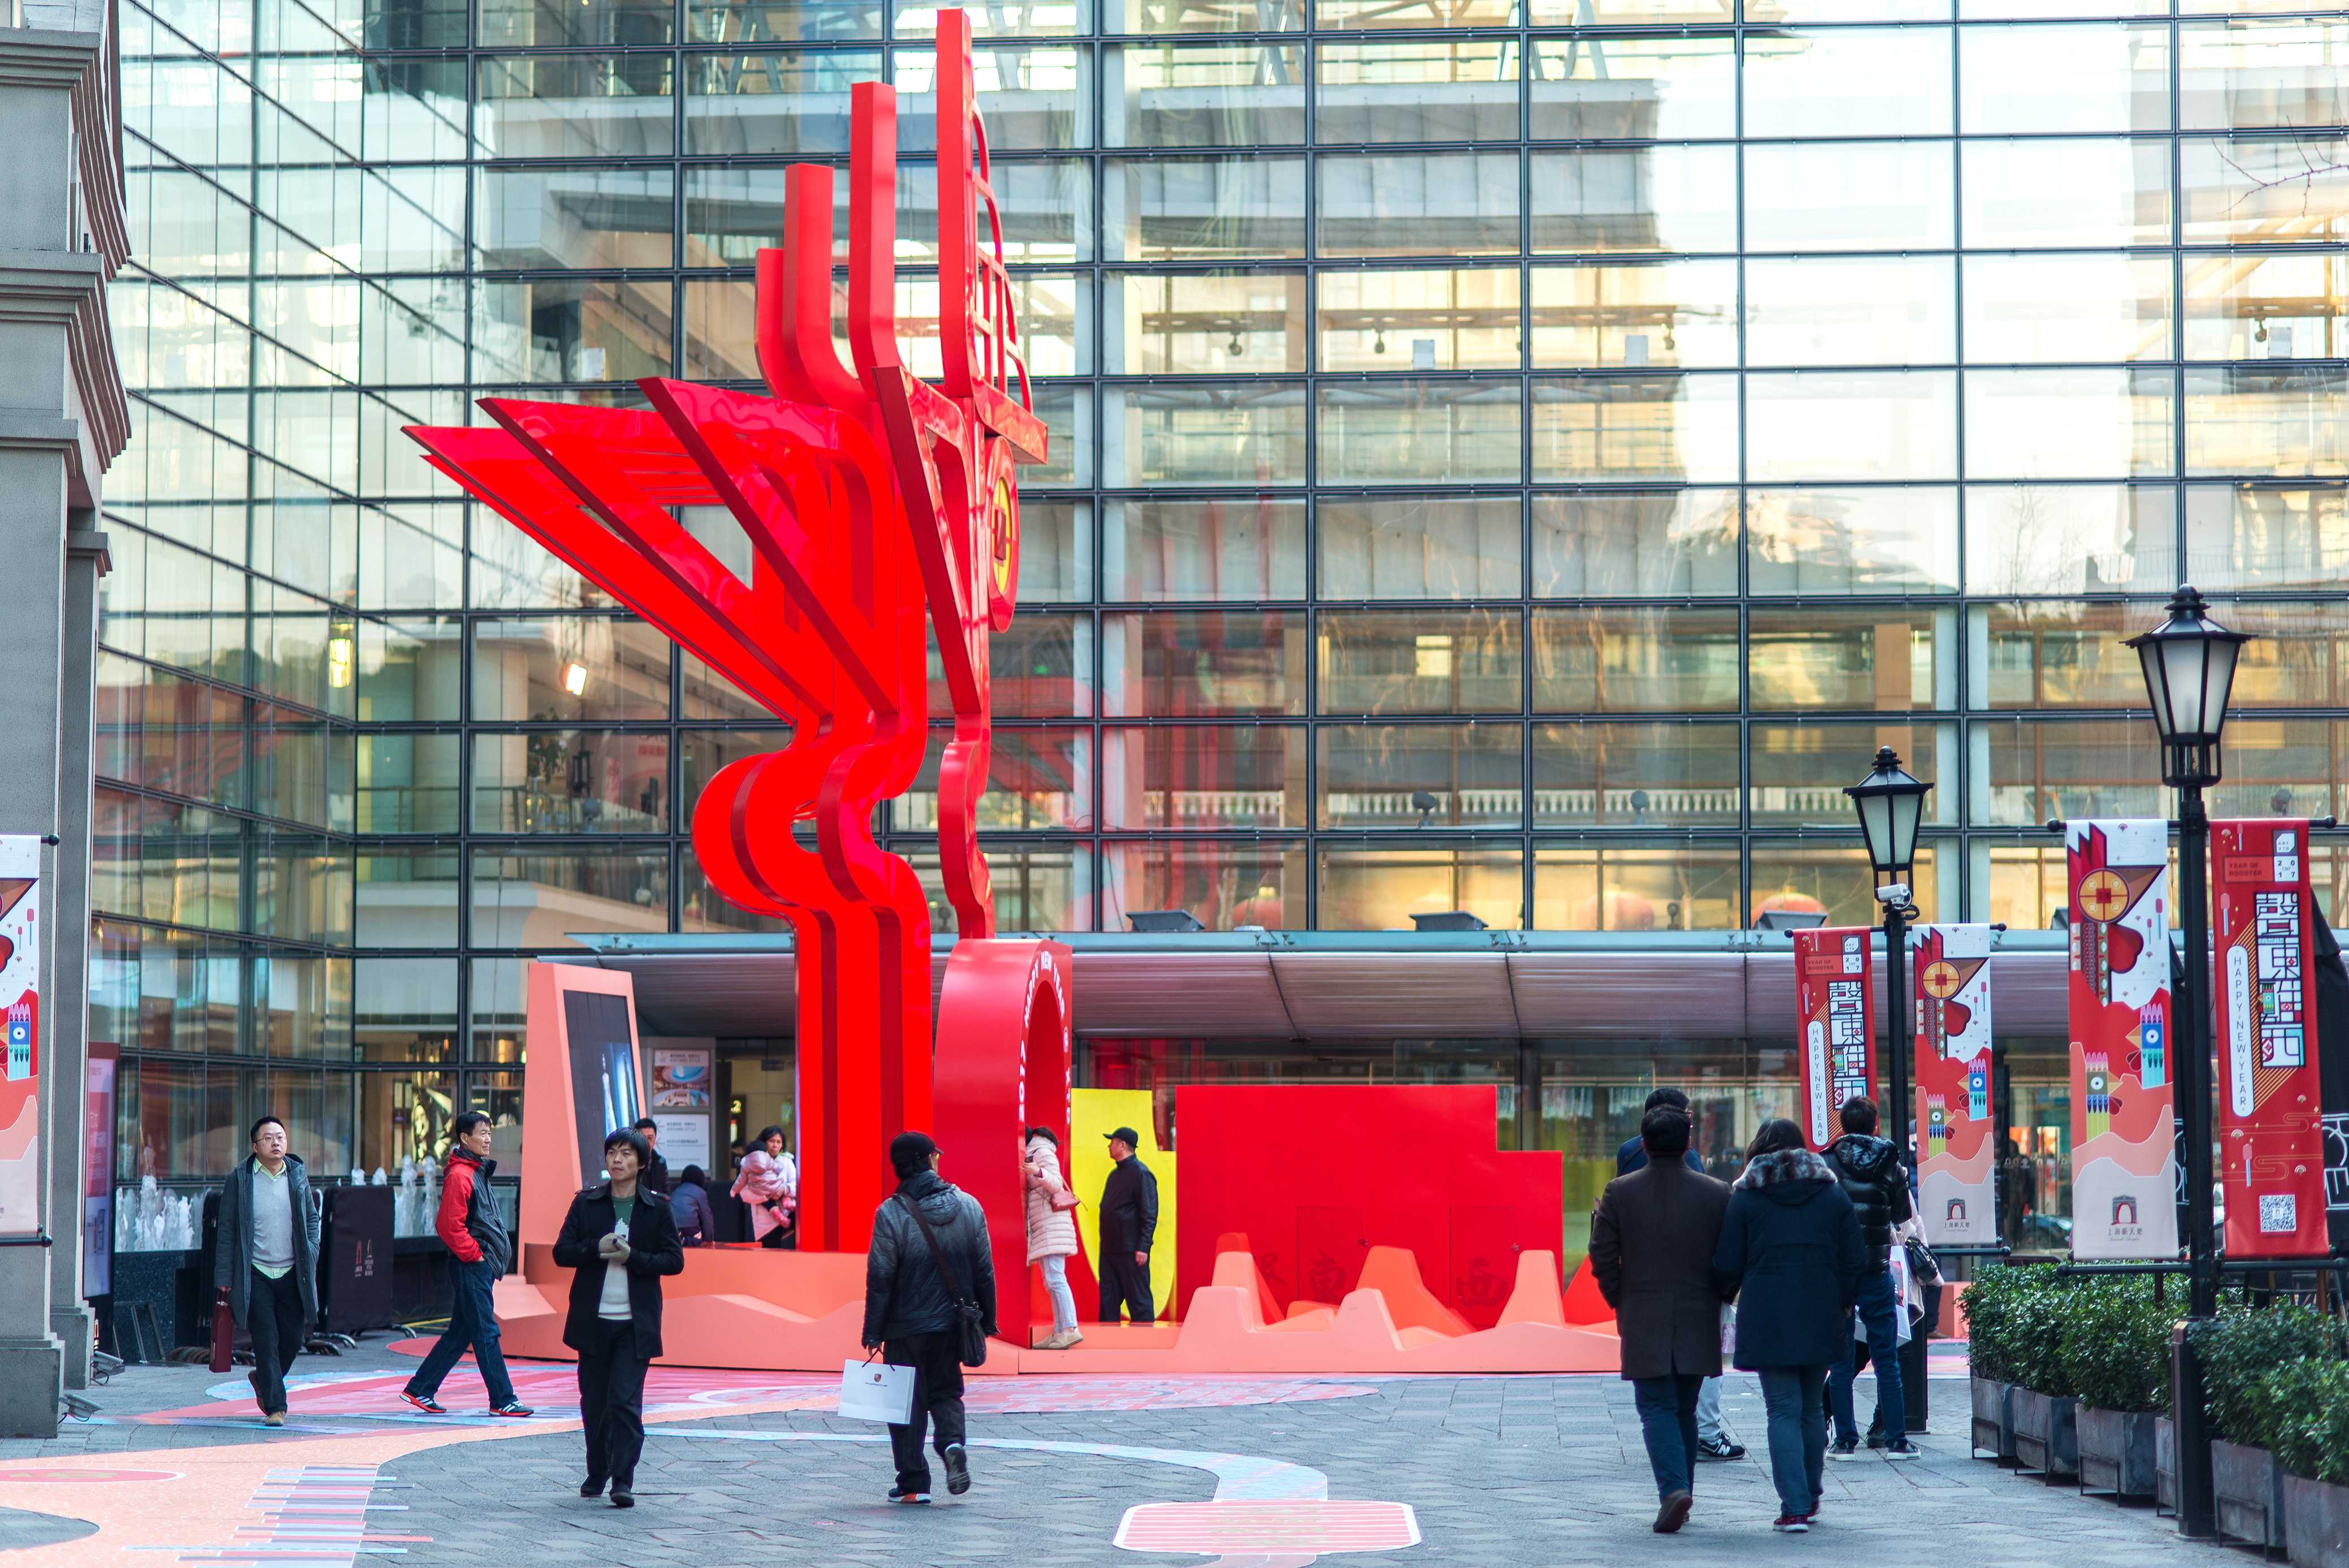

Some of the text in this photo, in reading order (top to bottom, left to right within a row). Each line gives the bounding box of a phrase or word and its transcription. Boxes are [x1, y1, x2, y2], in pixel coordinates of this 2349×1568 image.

[1024, 958, 1039, 1029] HAPPY
[1040, 950, 1052, 972] NEW
[1053, 962, 1066, 1020] YEAR
[2234, 956, 2243, 1010] HAPPY
[2237, 1021, 2246, 1053] NEW
